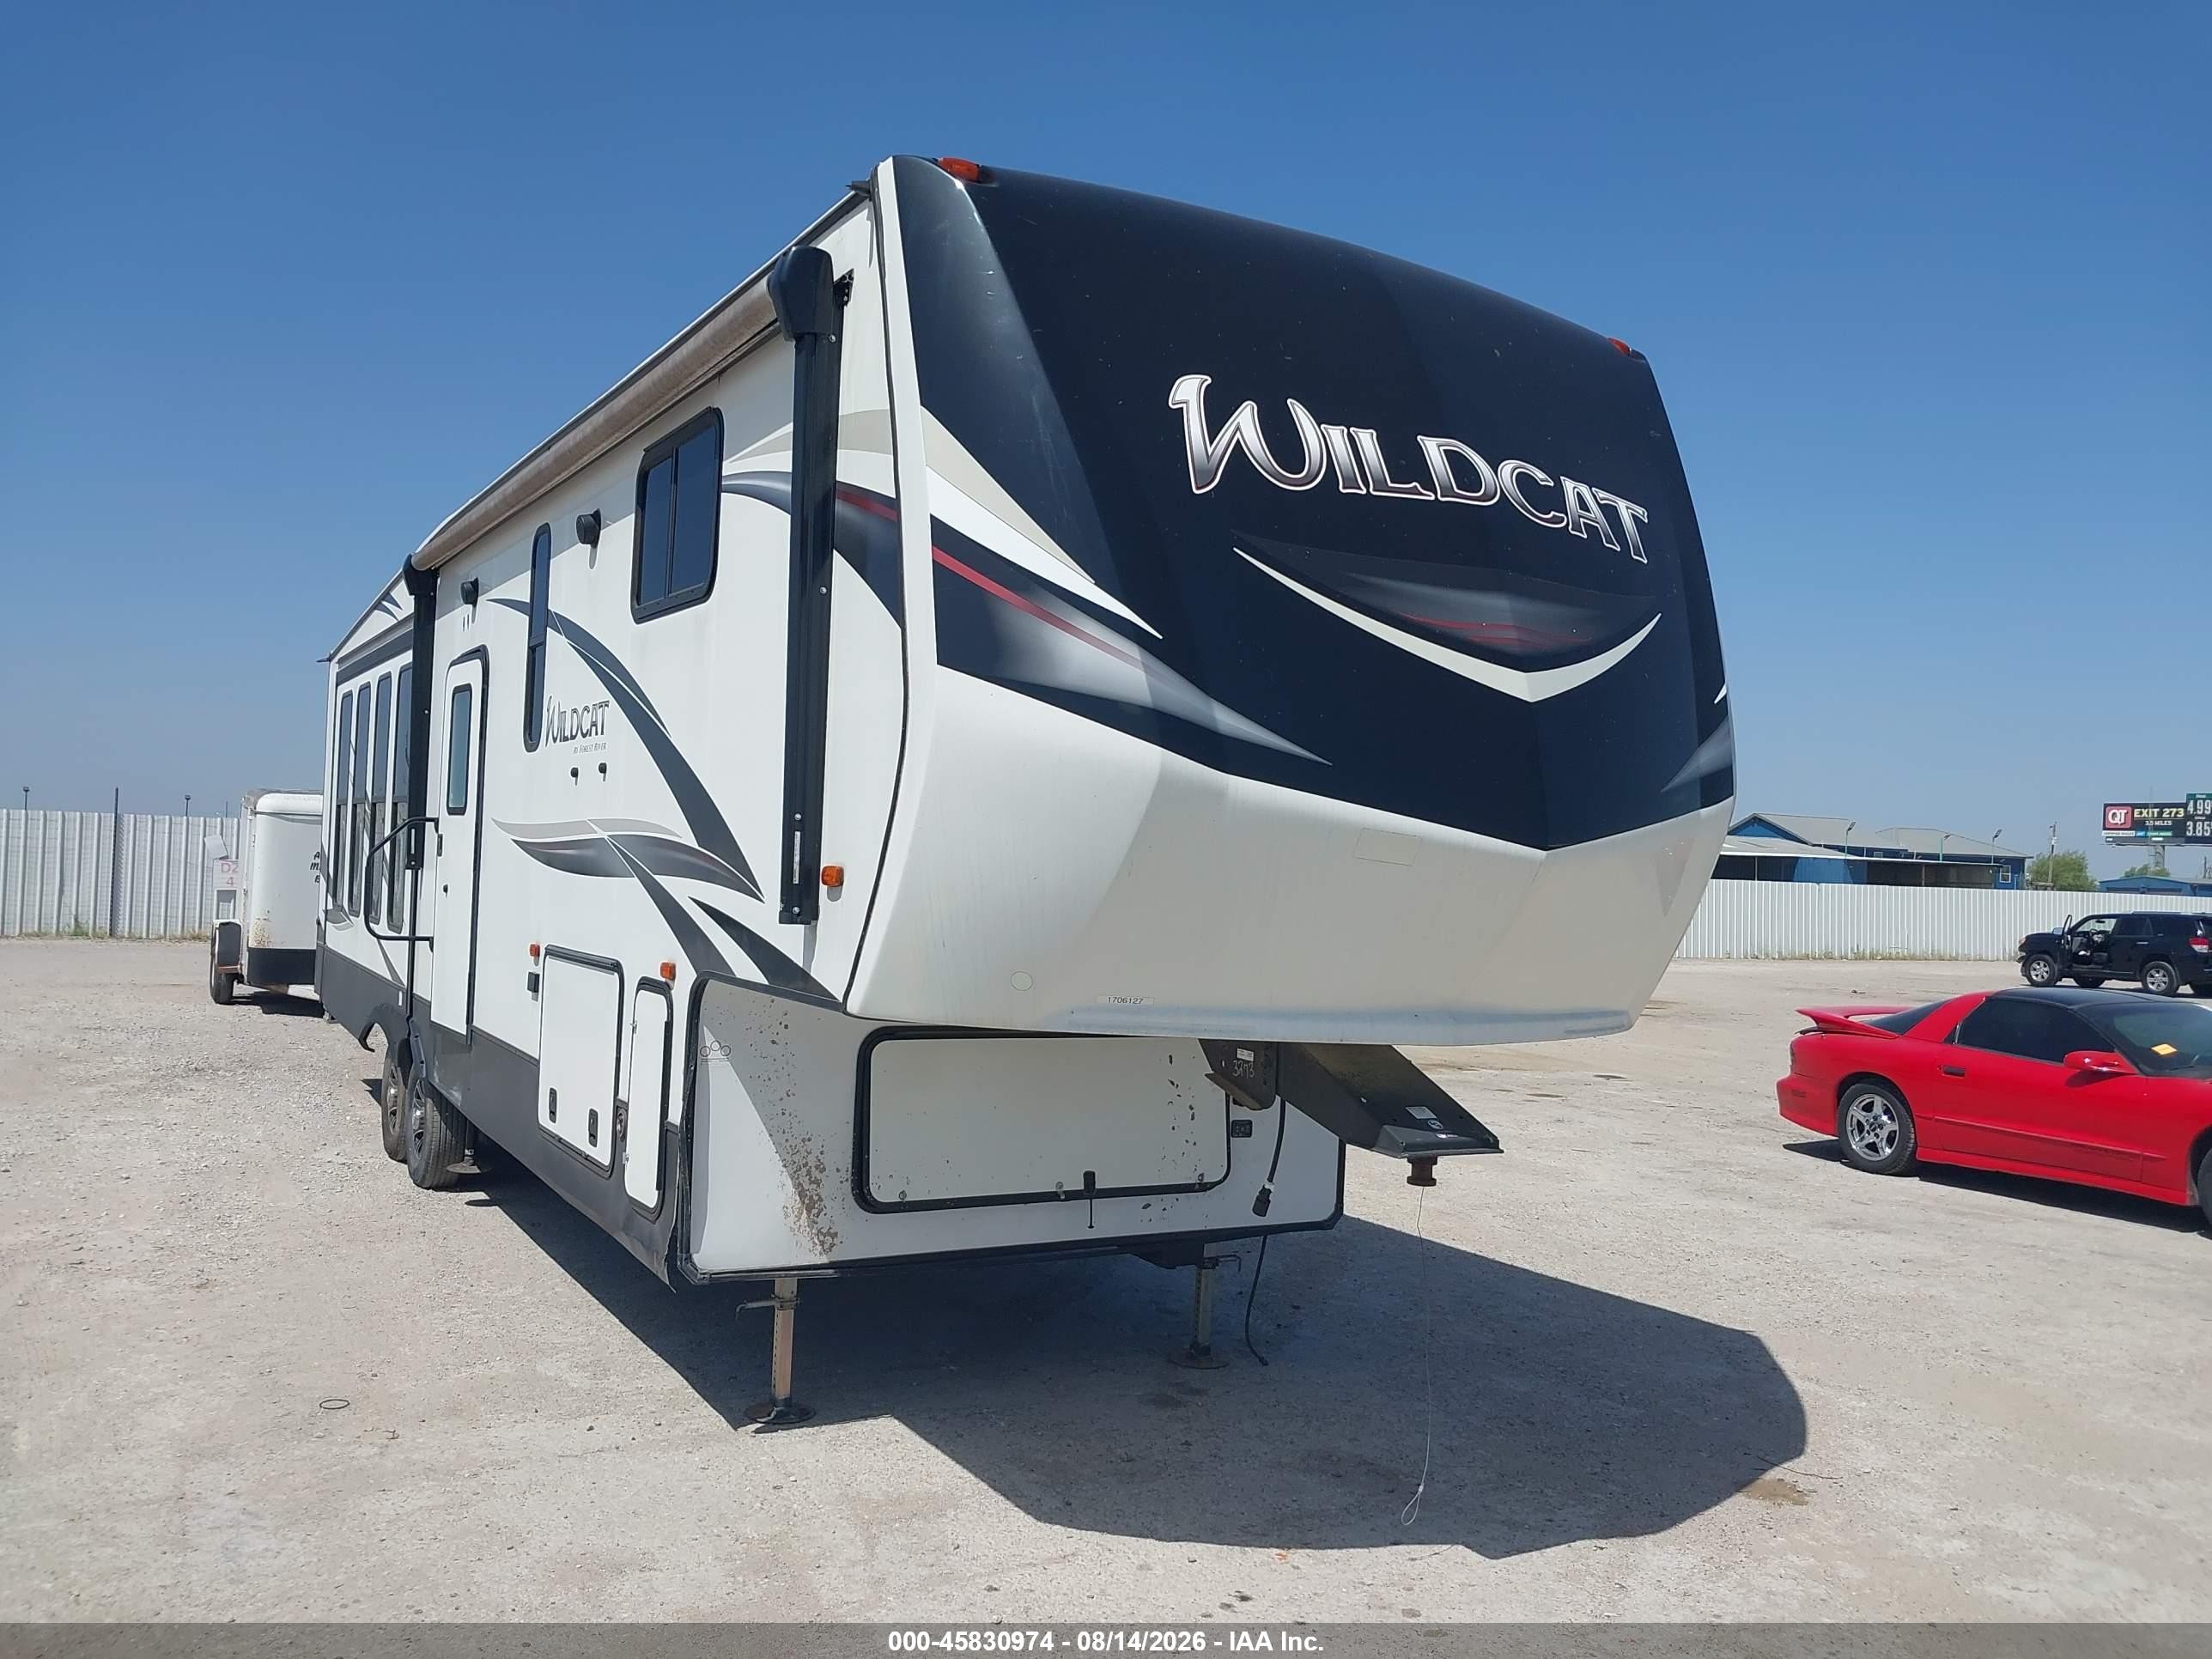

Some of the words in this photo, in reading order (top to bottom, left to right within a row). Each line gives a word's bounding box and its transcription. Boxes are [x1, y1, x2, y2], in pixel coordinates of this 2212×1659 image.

[1169, 374, 1648, 563] WILDCAT
[545, 695, 611, 748] WILDCAT
[2134, 808, 2160, 818] EXIT
[2162, 807, 2185, 817] 273
[2187, 799, 2212, 815] 4.99
[2107, 809, 2127, 825] QT
[2186, 821, 2212, 836] 3.85
[226, 876, 234, 887] 4
[1107, 996, 1144, 1005] 1706127
